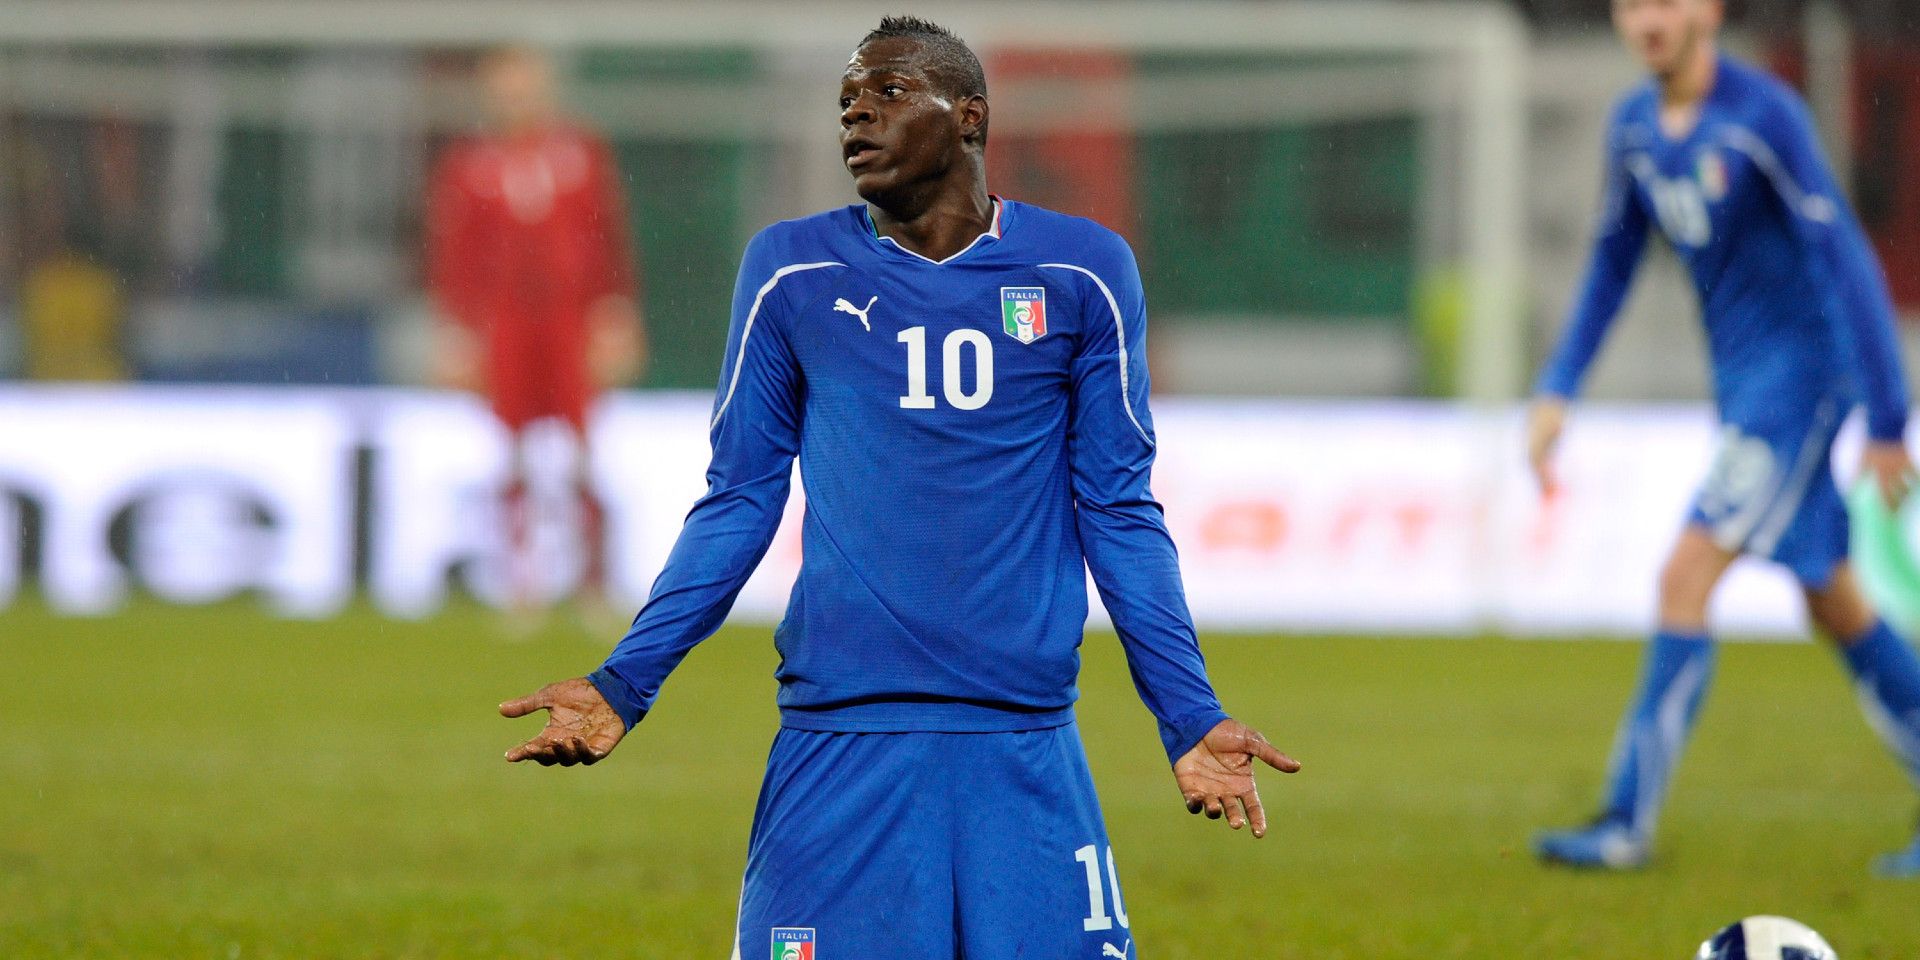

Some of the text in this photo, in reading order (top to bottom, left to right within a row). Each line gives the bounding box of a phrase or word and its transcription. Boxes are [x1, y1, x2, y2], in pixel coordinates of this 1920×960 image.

[1006, 292, 1039, 300] ITALIA
[897, 326, 994, 411] 10
[777, 932, 809, 940] ITALIA
